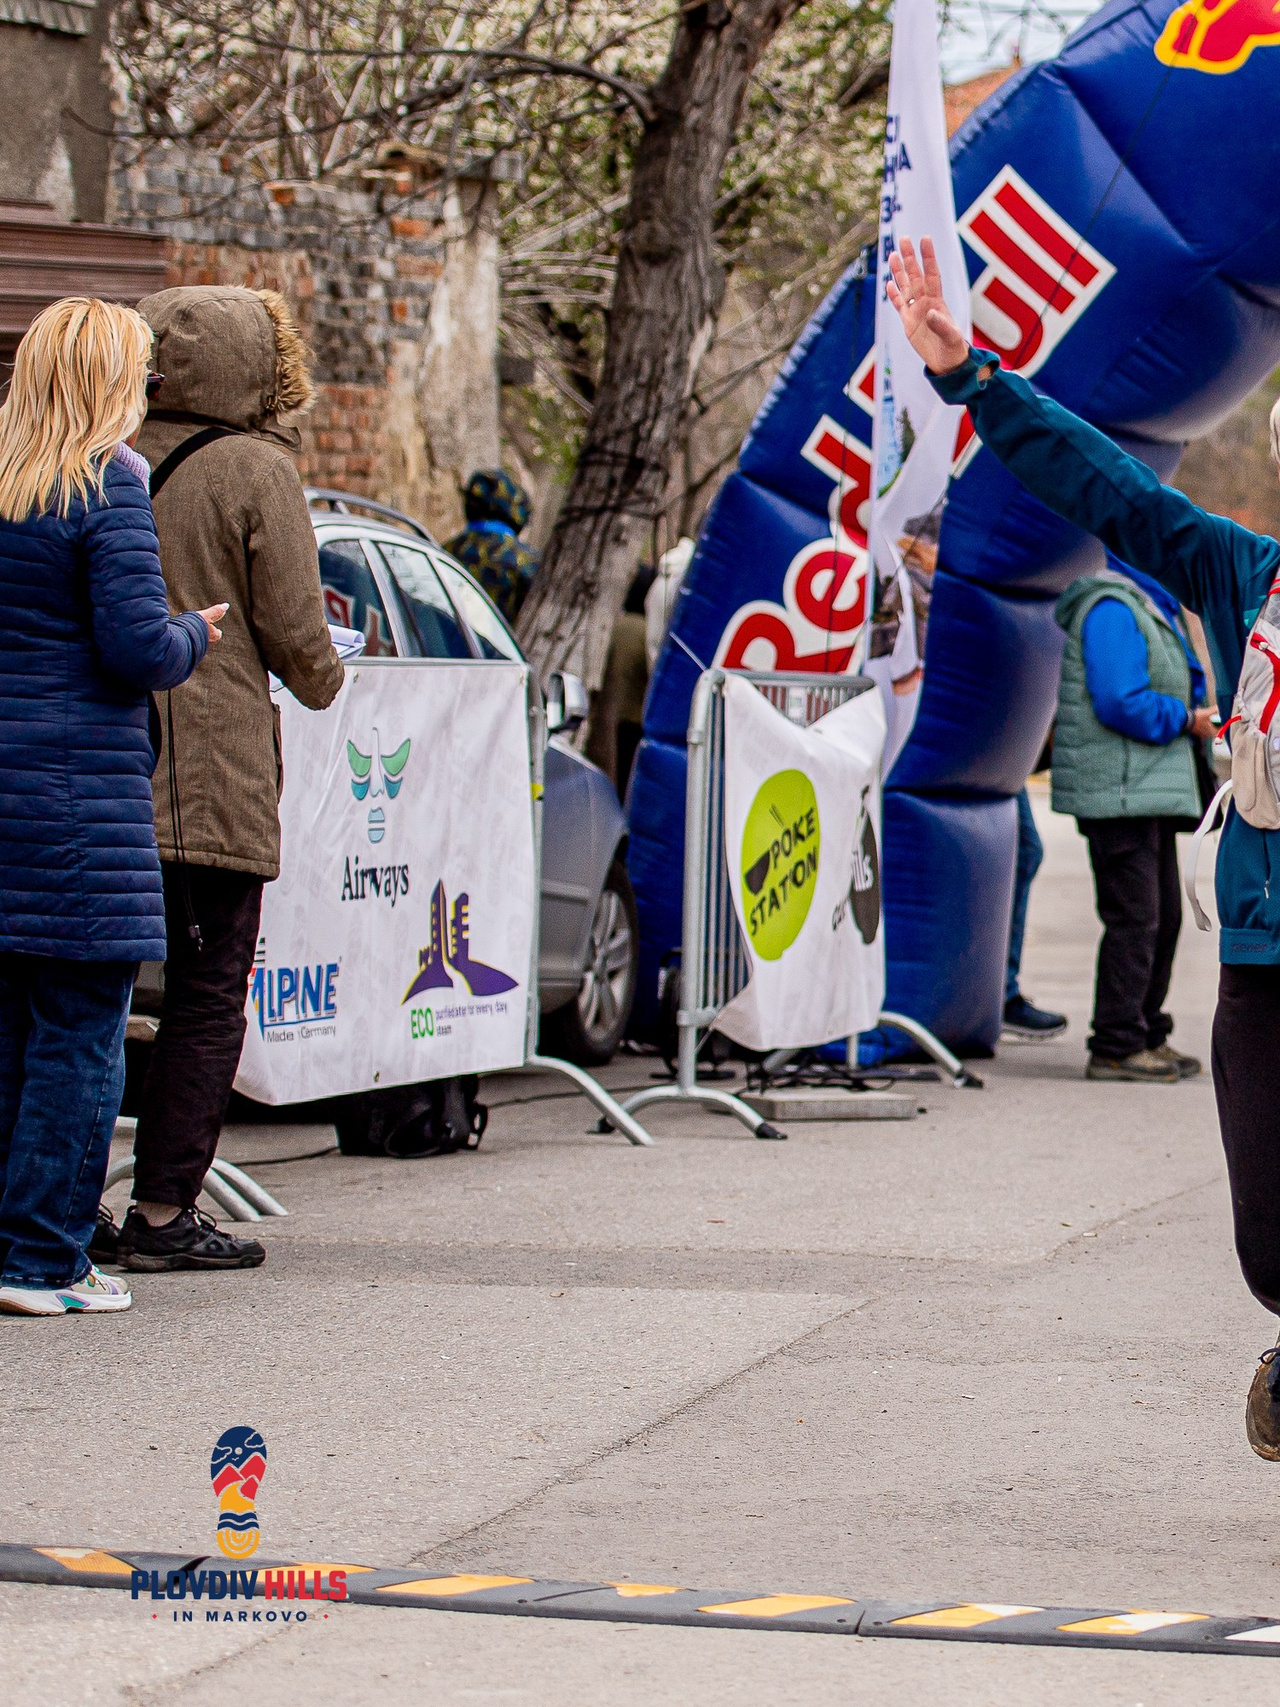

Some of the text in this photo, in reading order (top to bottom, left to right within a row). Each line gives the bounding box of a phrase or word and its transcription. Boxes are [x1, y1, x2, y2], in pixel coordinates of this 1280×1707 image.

[722, 181, 1098, 674] Red ull
[770, 808, 815, 869] POKE
[341, 854, 409, 907] Airways
[410, 1007, 434, 1039] ECO
